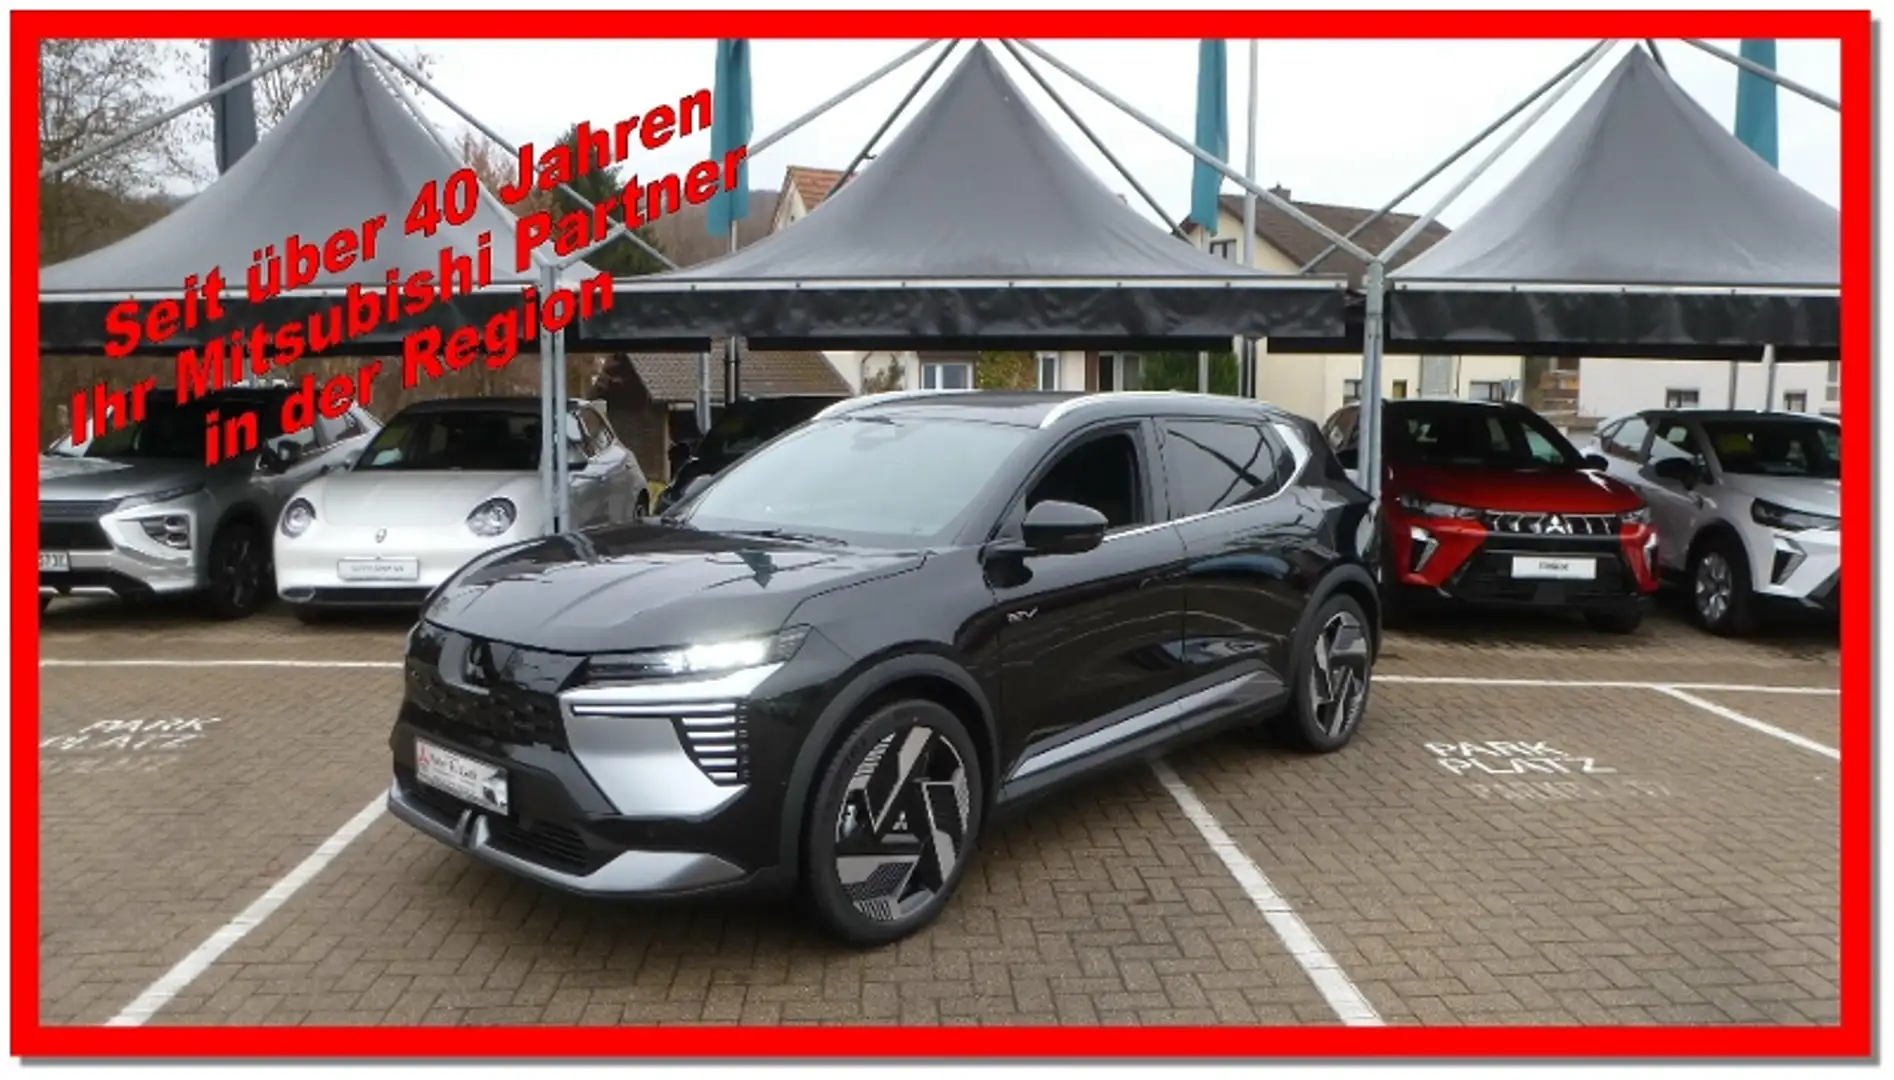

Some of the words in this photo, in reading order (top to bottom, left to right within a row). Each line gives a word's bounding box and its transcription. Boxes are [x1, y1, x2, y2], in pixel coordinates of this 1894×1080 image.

[78, 717, 222, 734] PARK
[1424, 740, 1569, 757] PARK
[1438, 756, 1618, 775] PLATZ
